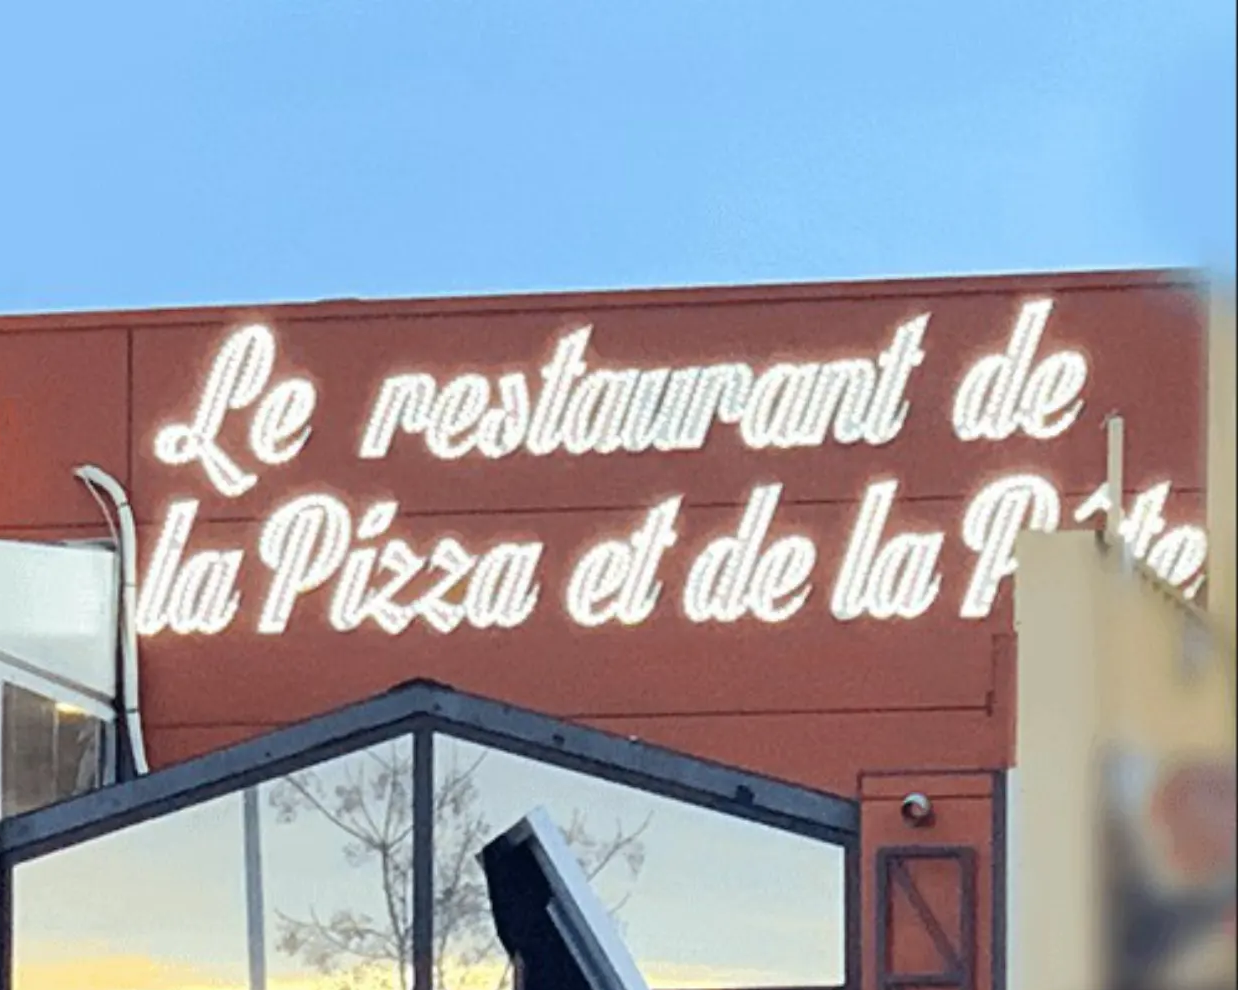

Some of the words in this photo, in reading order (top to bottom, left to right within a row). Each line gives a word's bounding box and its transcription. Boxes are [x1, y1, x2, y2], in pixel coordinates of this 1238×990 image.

[153, 323, 317, 497] Le
[359, 313, 932, 460] restaurant
[951, 297, 1088, 442] de
[134, 498, 244, 635] la
[257, 493, 544, 635] Pizza
[565, 495, 684, 627] et
[682, 482, 817, 623] de
[829, 479, 945, 620] la
[959, 473, 1209, 618] Pte
